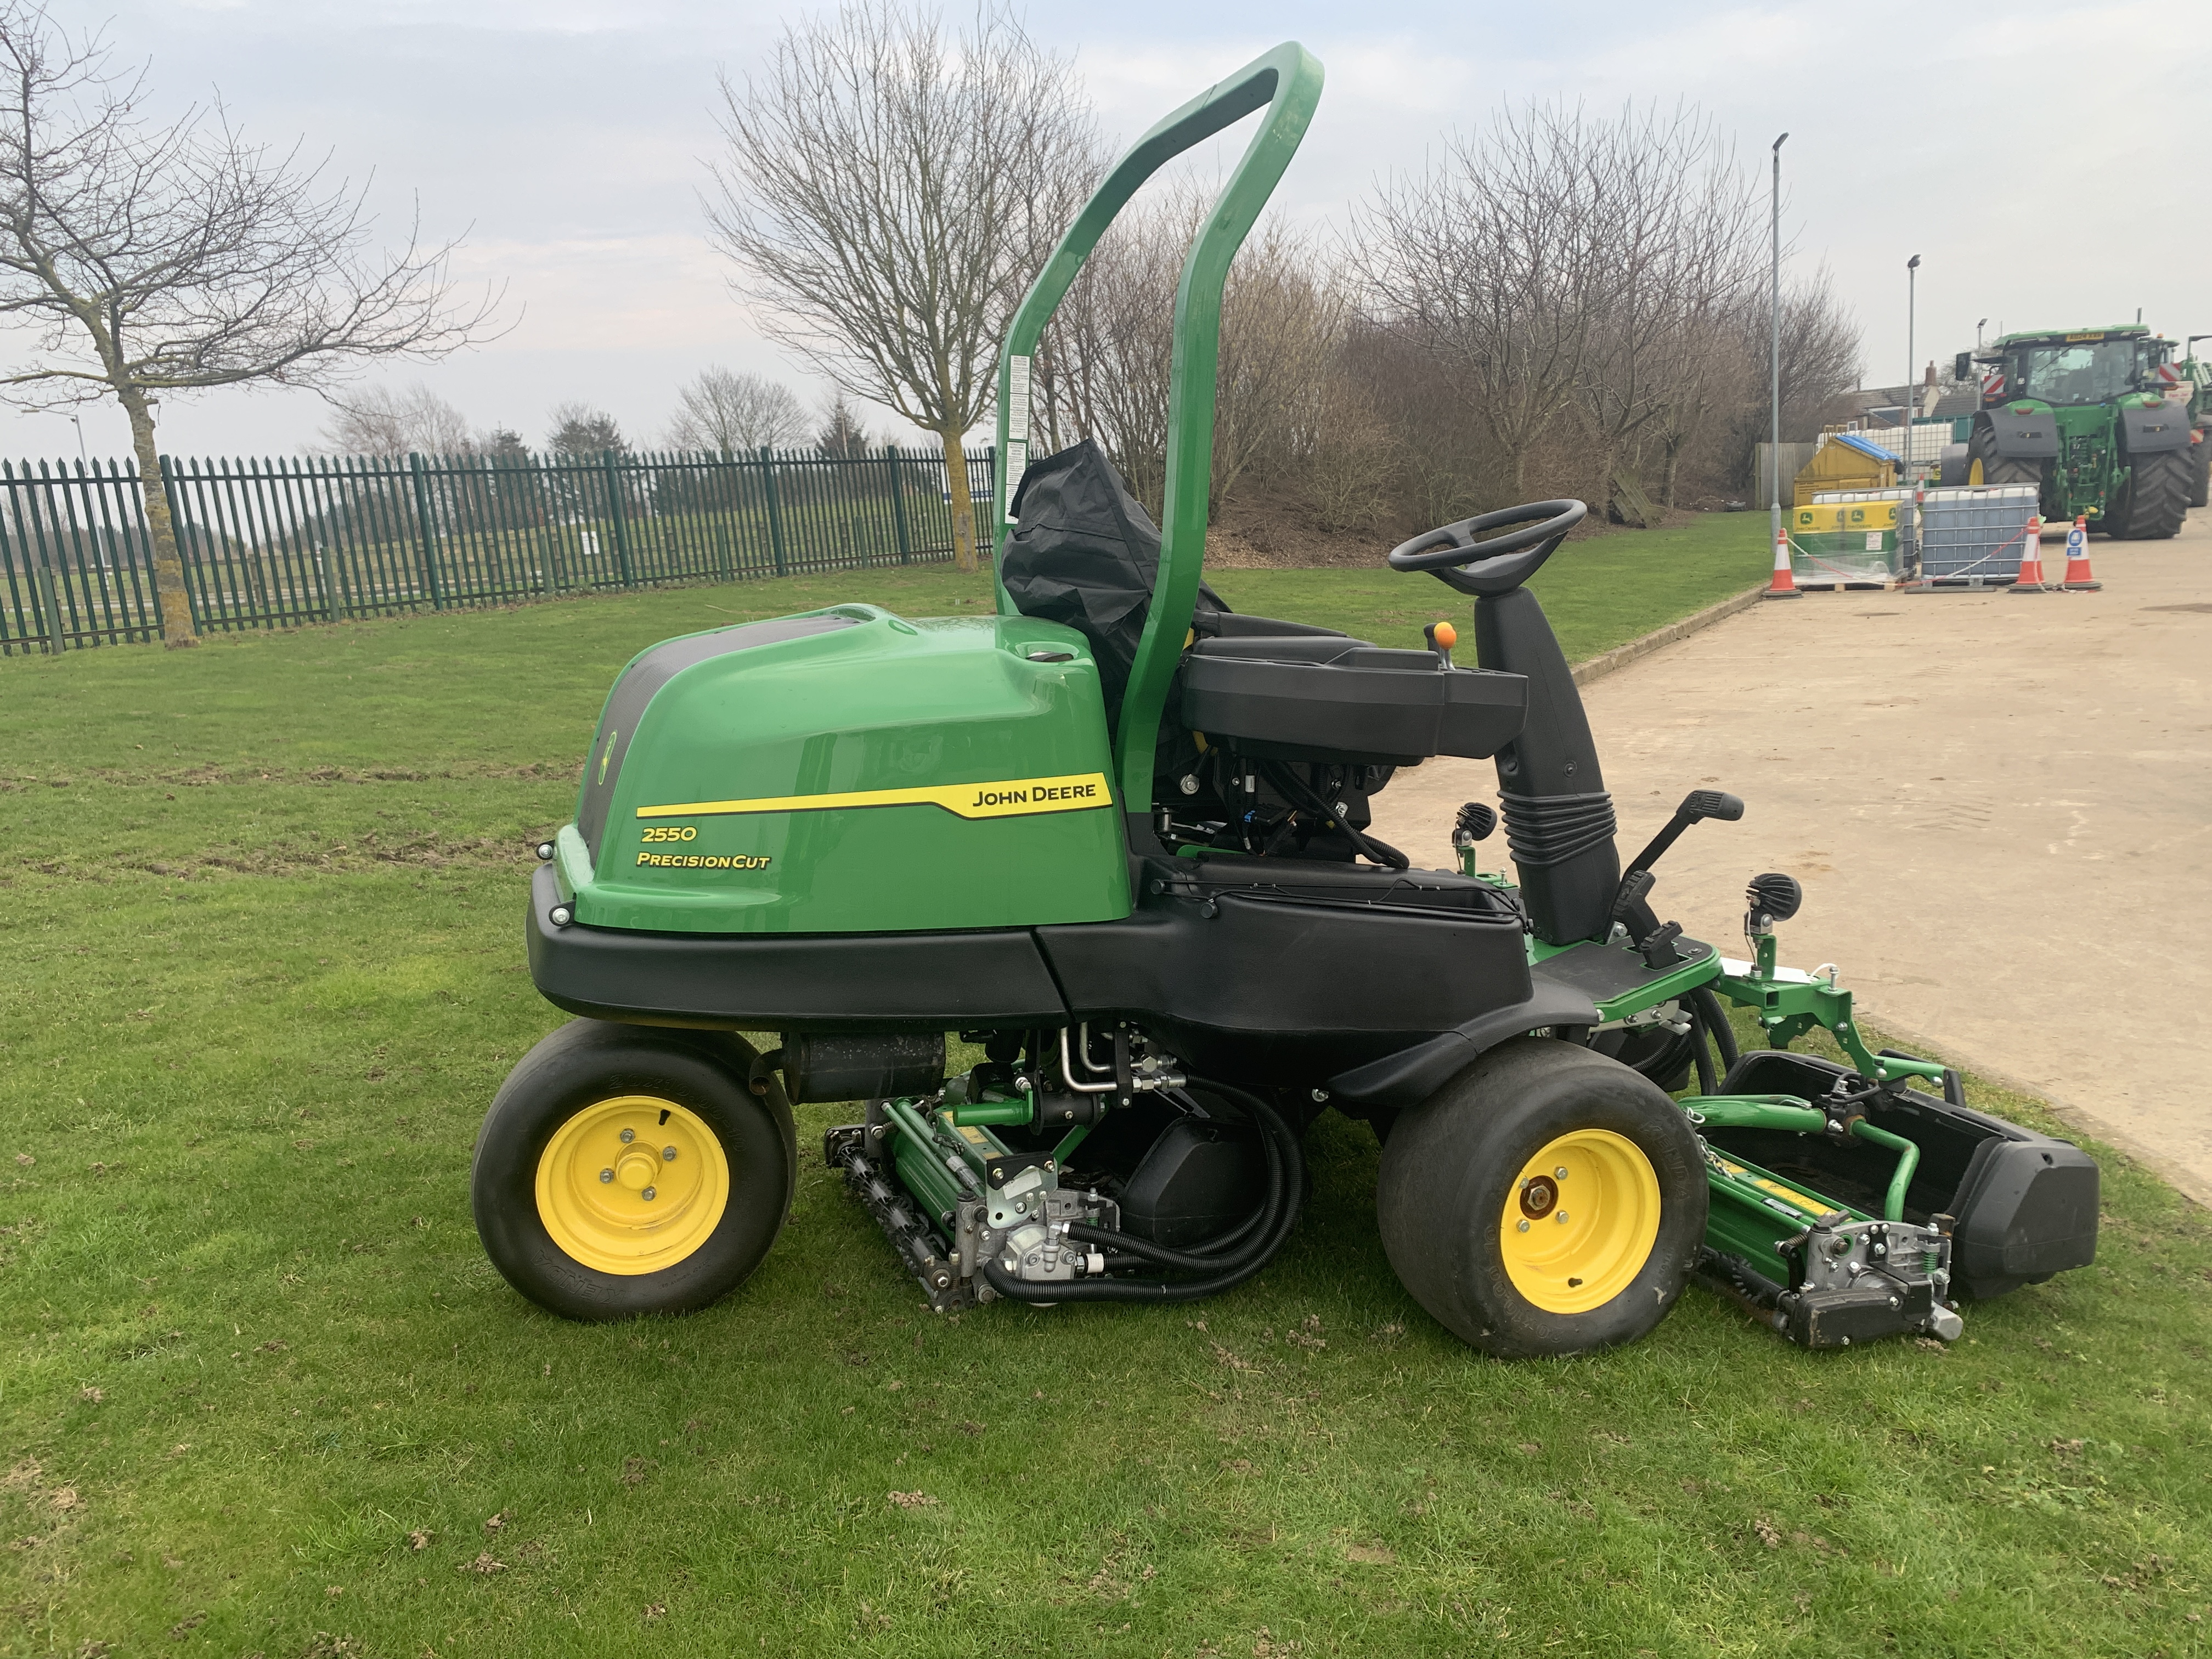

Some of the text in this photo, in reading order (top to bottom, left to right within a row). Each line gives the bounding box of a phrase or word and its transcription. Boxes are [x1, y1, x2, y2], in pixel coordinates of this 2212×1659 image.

[973, 784, 1096, 807] JOHN DEERE
[641, 827, 697, 843] 2550
[1638, 1121, 1691, 1200] KENDA
[531, 1249, 626, 1306] KENDA
